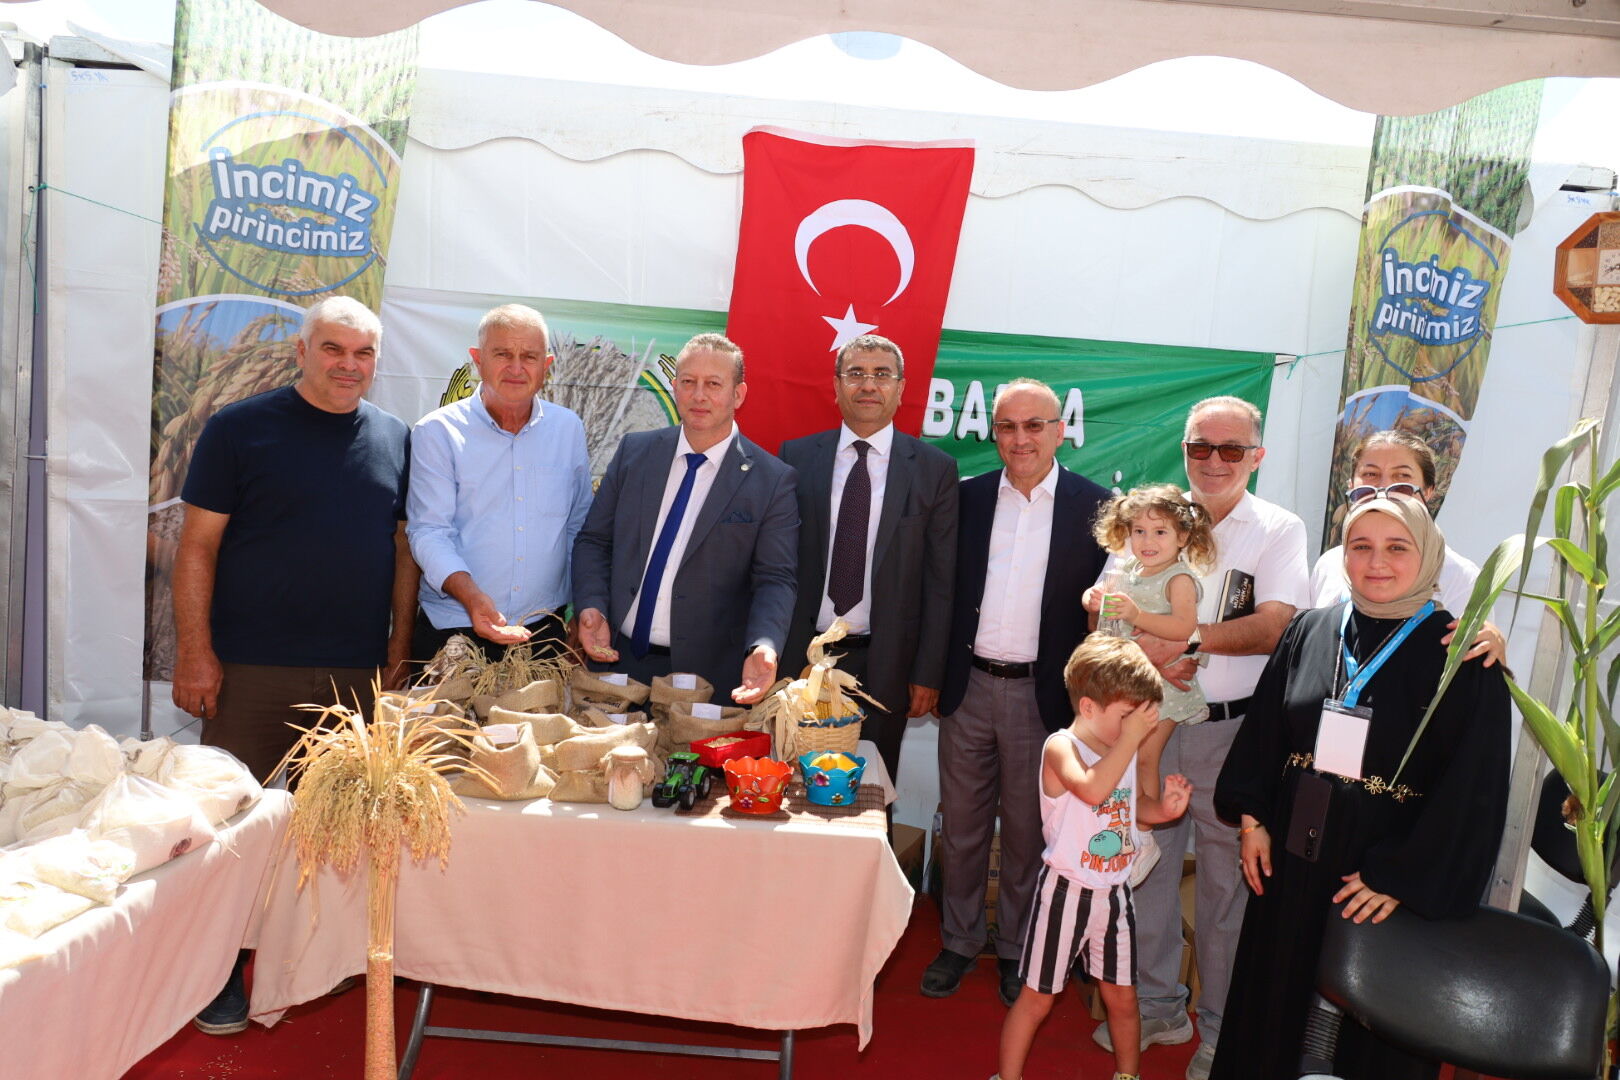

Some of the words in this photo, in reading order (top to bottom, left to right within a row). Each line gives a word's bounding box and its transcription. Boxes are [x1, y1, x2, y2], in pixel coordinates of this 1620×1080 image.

[215, 152, 373, 223] İncimiz
[209, 206, 365, 251] pirincimiz
[1376, 302, 1475, 340] pirinmiz
[922, 377, 1085, 449] BAA
